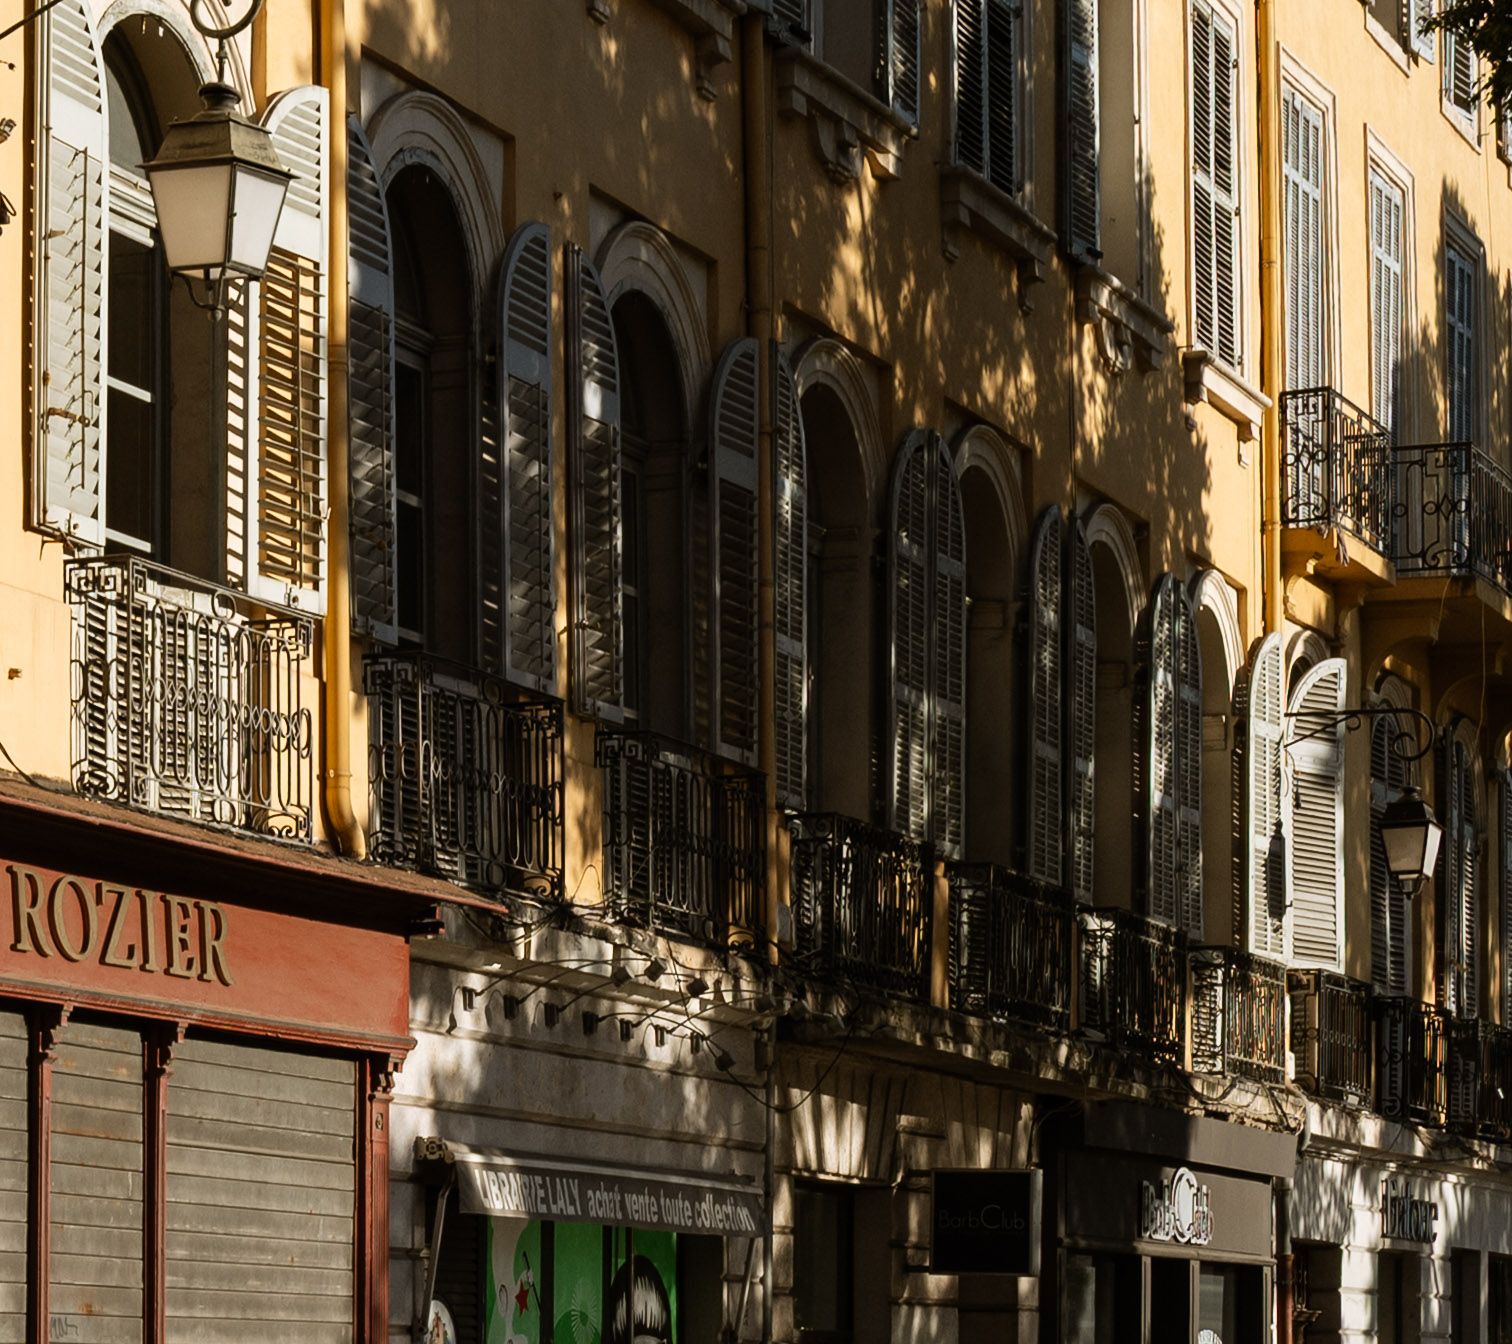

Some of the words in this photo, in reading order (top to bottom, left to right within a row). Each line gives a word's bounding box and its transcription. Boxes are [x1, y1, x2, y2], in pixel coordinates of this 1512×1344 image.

[6, 865, 233, 987] ROZIER
[475, 1168, 546, 1212] LIBRAIRIE
[543, 1177, 582, 1216] LALY
[587, 1181, 622, 1220] achat
[624, 1187, 658, 1223] vente
[660, 1188, 692, 1227] toute
[694, 1192, 756, 1232] collection
